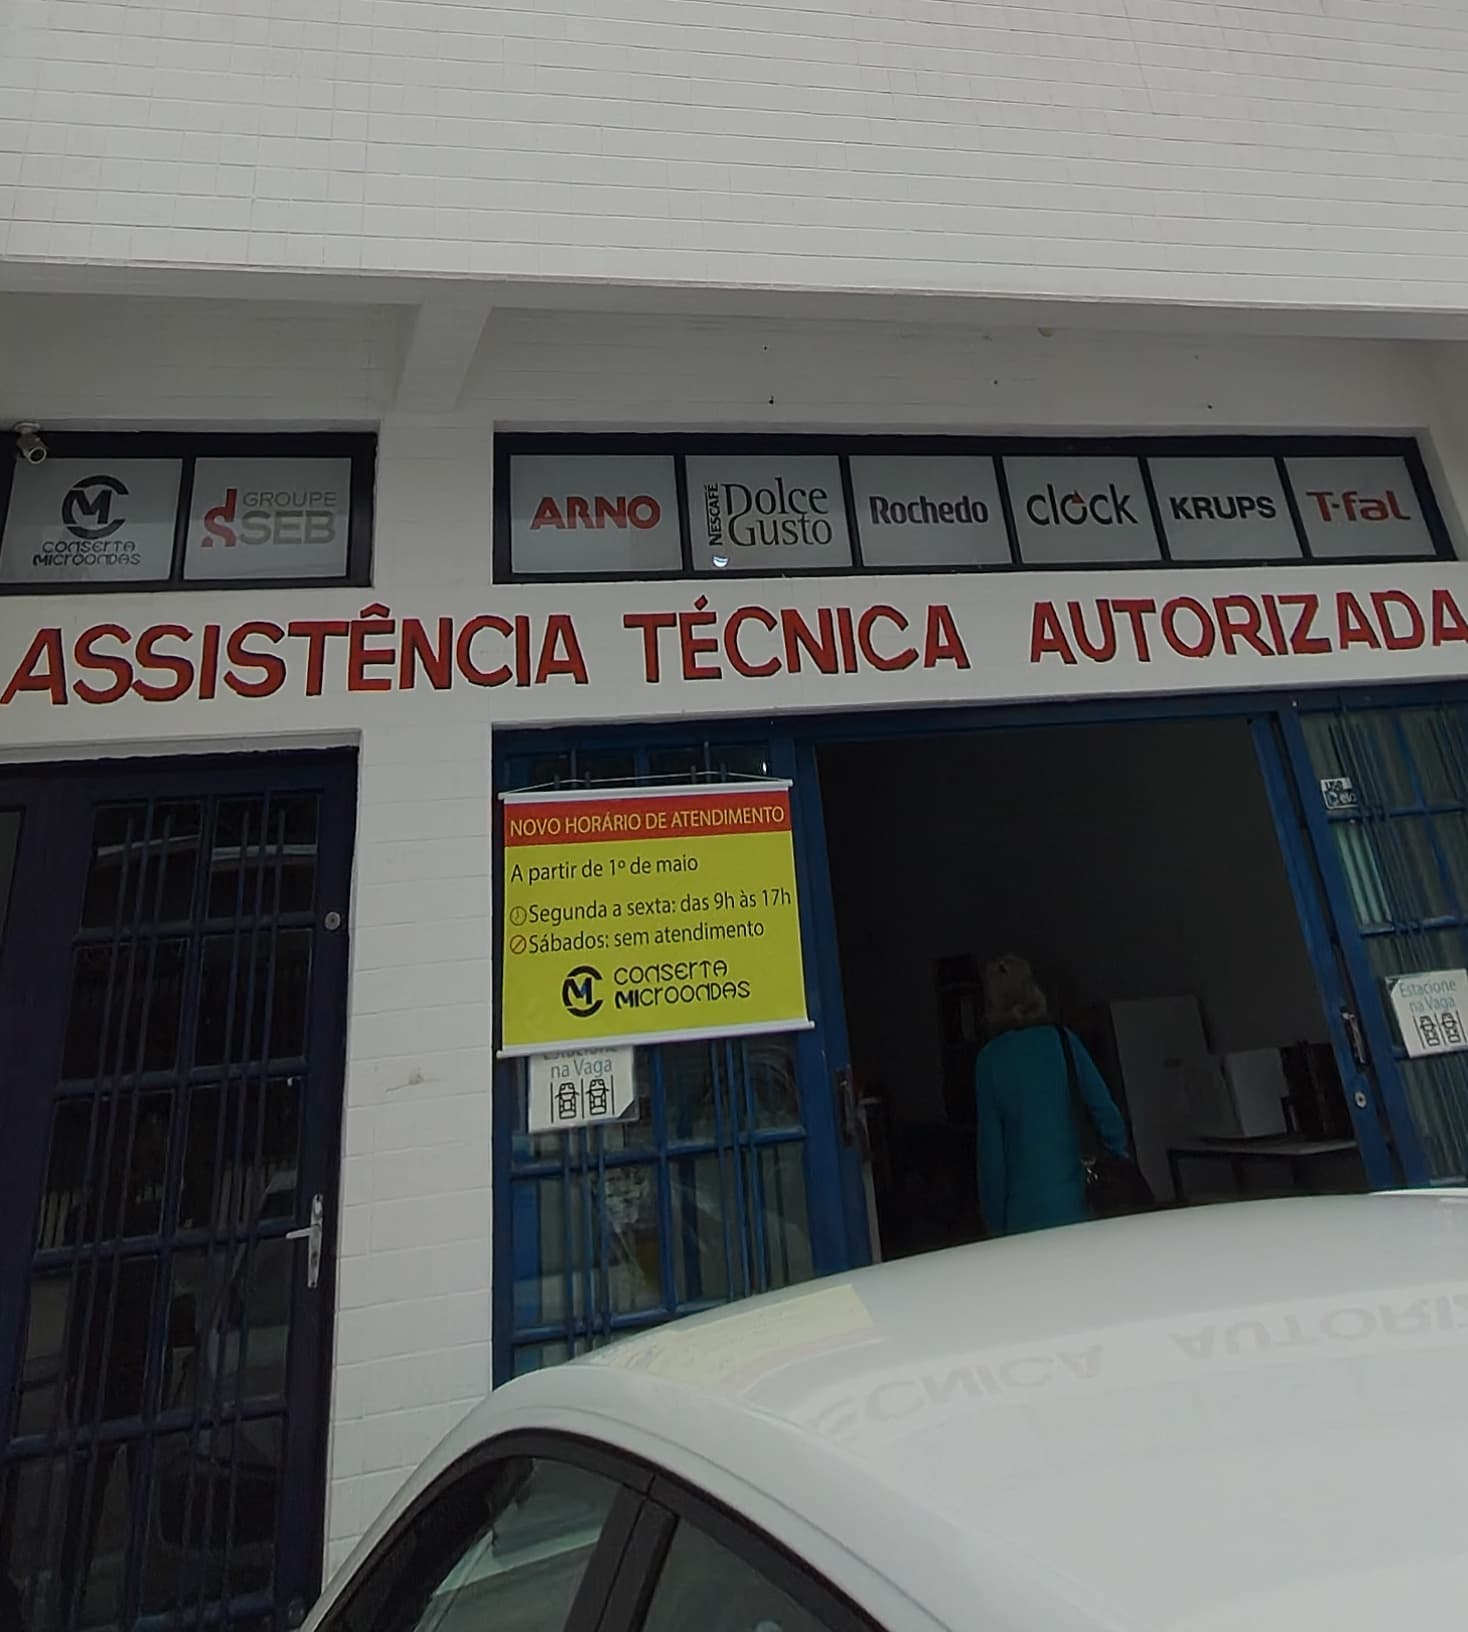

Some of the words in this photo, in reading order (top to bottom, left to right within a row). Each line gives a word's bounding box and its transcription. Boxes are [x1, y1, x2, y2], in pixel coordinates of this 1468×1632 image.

[242, 491, 337, 508] GROUPE
[721, 476, 829, 515] Dolce
[870, 495, 989, 525] Rochedo
[1026, 483, 1139, 526] clock
[1170, 495, 1276, 521] KRUPS
[1306, 489, 1411, 522] T-fal
[238, 510, 336, 545] SEB
[530, 495, 662, 530] ARNO
[728, 514, 832, 546] Gusto
[0, 603, 589, 705] ASSISTÊNCIA
[623, 595, 970, 683] TÉCNICA
[1030, 589, 1468, 665] AUTORIZADA
[510, 818, 561, 837] NOVO
[566, 812, 641, 834] HORÁRIO
[646, 812, 667, 830] DE
[671, 806, 785, 828] ATENDIMENTO
[511, 864, 523, 883] A
[528, 862, 577, 885] partir
[582, 859, 603, 878] de
[630, 856, 651, 875] de
[656, 854, 698, 873] maio
[529, 900, 607, 927] Segunda
[612, 903, 622, 917] a
[627, 898, 676, 916] sexta:
[681, 894, 709, 912] das
[714, 890, 735, 909] 9h
[740, 889, 757, 908] às
[762, 888, 791, 906] 17h
[529, 931, 609, 954] Sábados:
[614, 930, 650, 947] sem
[655, 920, 765, 944] atendimento
[1399, 979, 1456, 998] Estacione
[1410, 1001, 1425, 1013] na
[551, 1065, 570, 1078] na
[573, 1058, 613, 1078] Vaga
